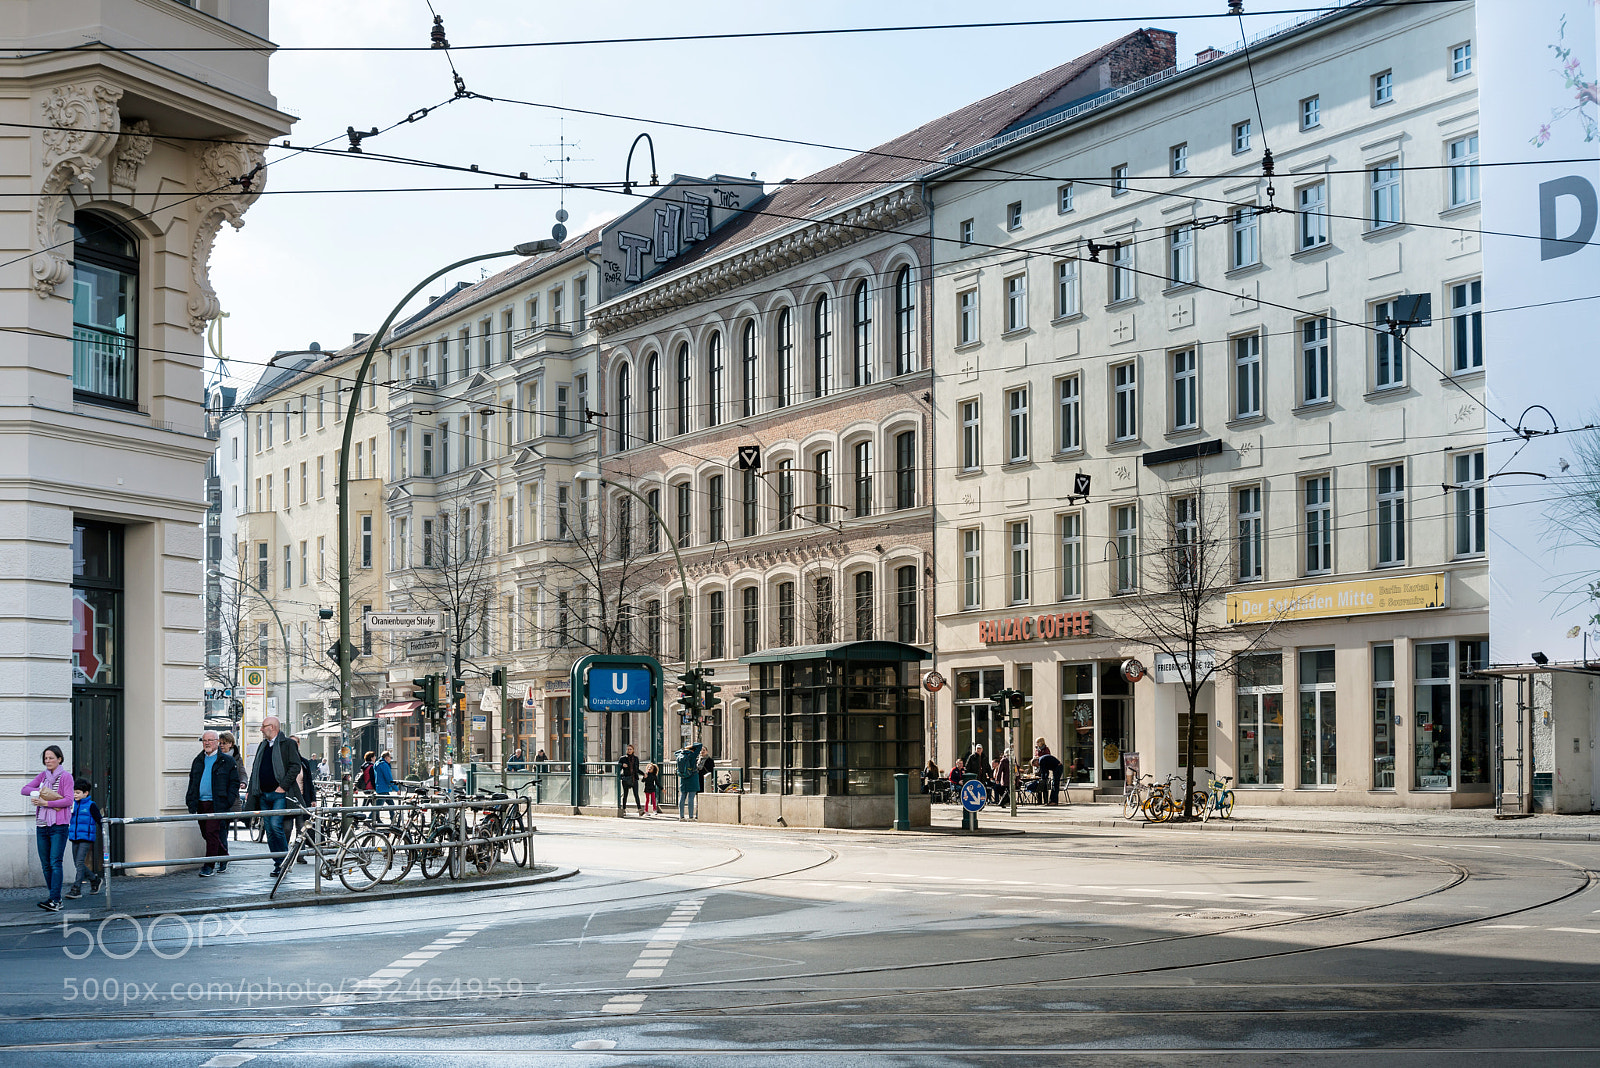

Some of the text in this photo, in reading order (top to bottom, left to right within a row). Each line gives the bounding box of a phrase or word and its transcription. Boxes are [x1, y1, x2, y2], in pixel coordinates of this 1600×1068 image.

[1538, 175, 1598, 262] D
[1242, 600, 1263, 615] Der
[1268, 594, 1333, 613] Fotoladen
[1338, 590, 1374, 607] Mitte
[371, 615, 436, 627] Oranienburger Straße
[979, 611, 1092, 643] BALZAC COFFEE
[612, 672, 628, 694] U
[592, 697, 647, 706] Oranienburger Tor
